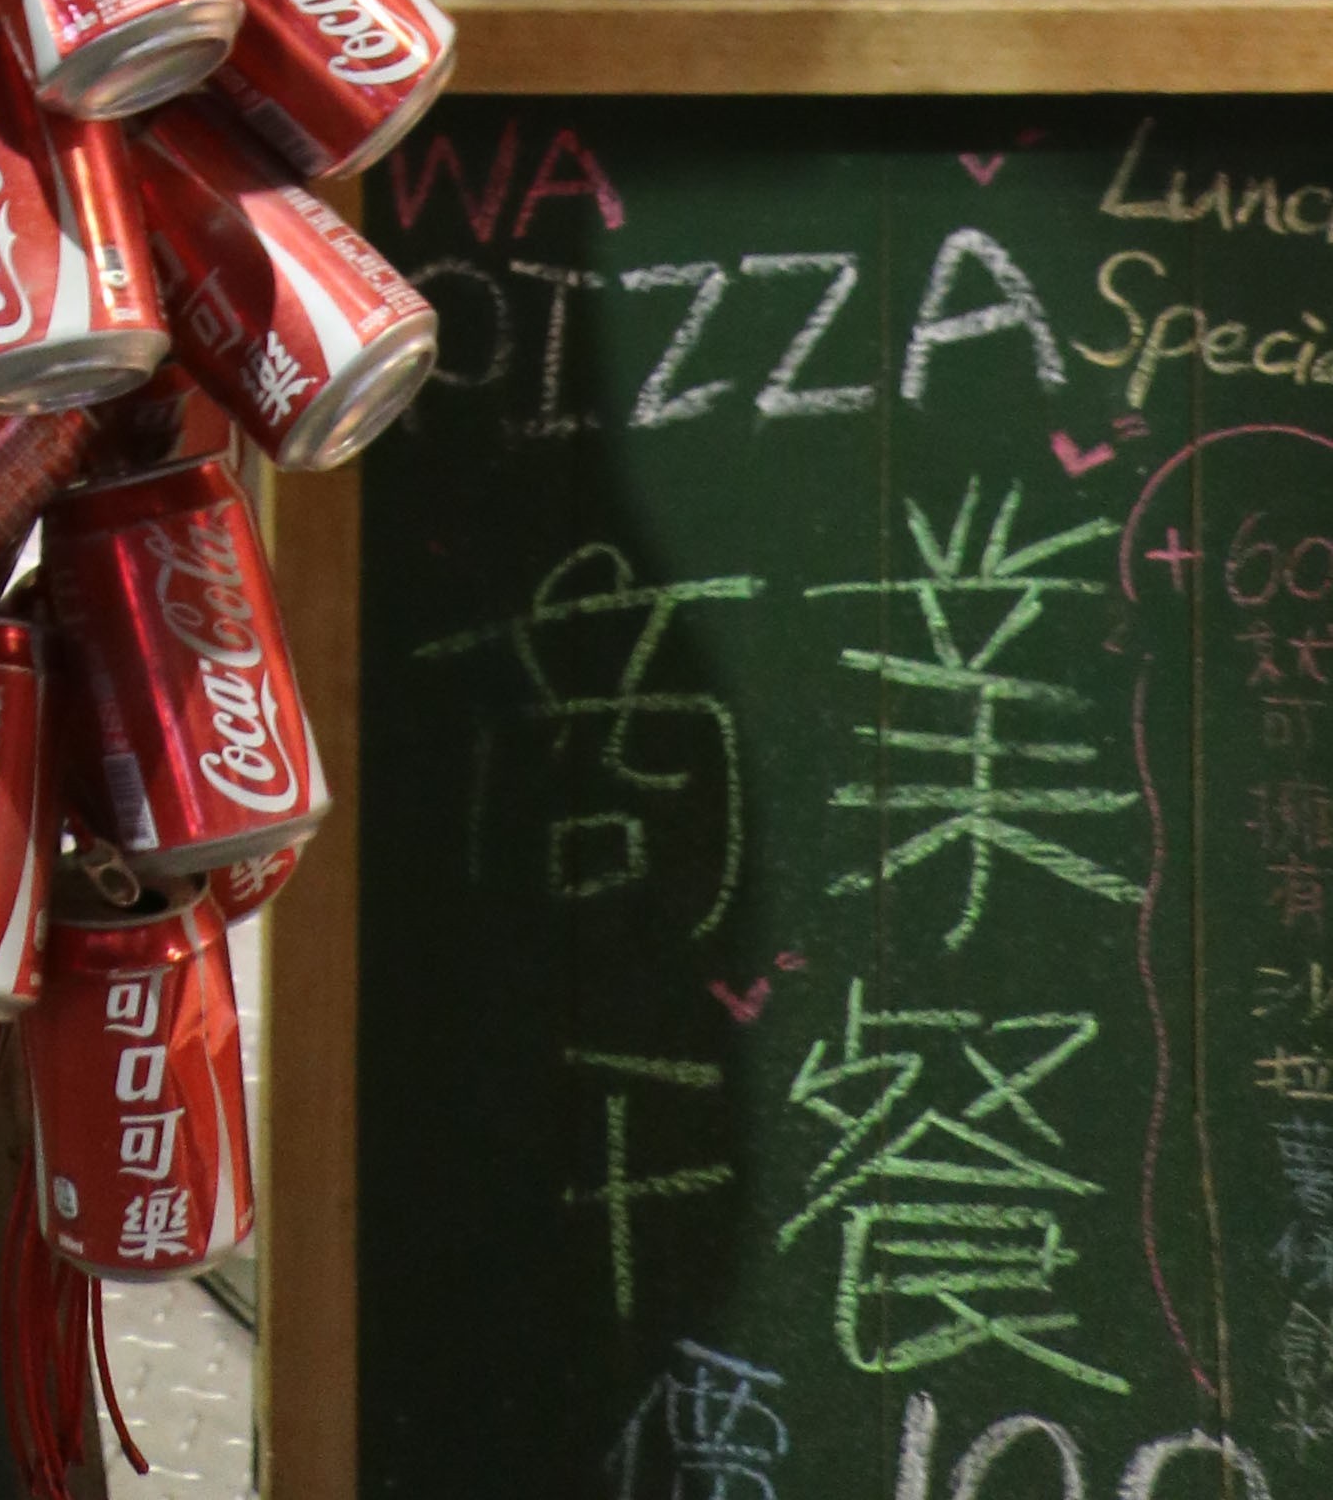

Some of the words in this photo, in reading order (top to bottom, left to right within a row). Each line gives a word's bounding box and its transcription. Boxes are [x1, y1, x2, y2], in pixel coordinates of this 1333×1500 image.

[389, 118, 625, 243] WA
[1099, 116, 1333, 243] Lunc
[144, 498, 299, 814] Coca-Cola
[105, 966, 196, 1261] 可口可樂
